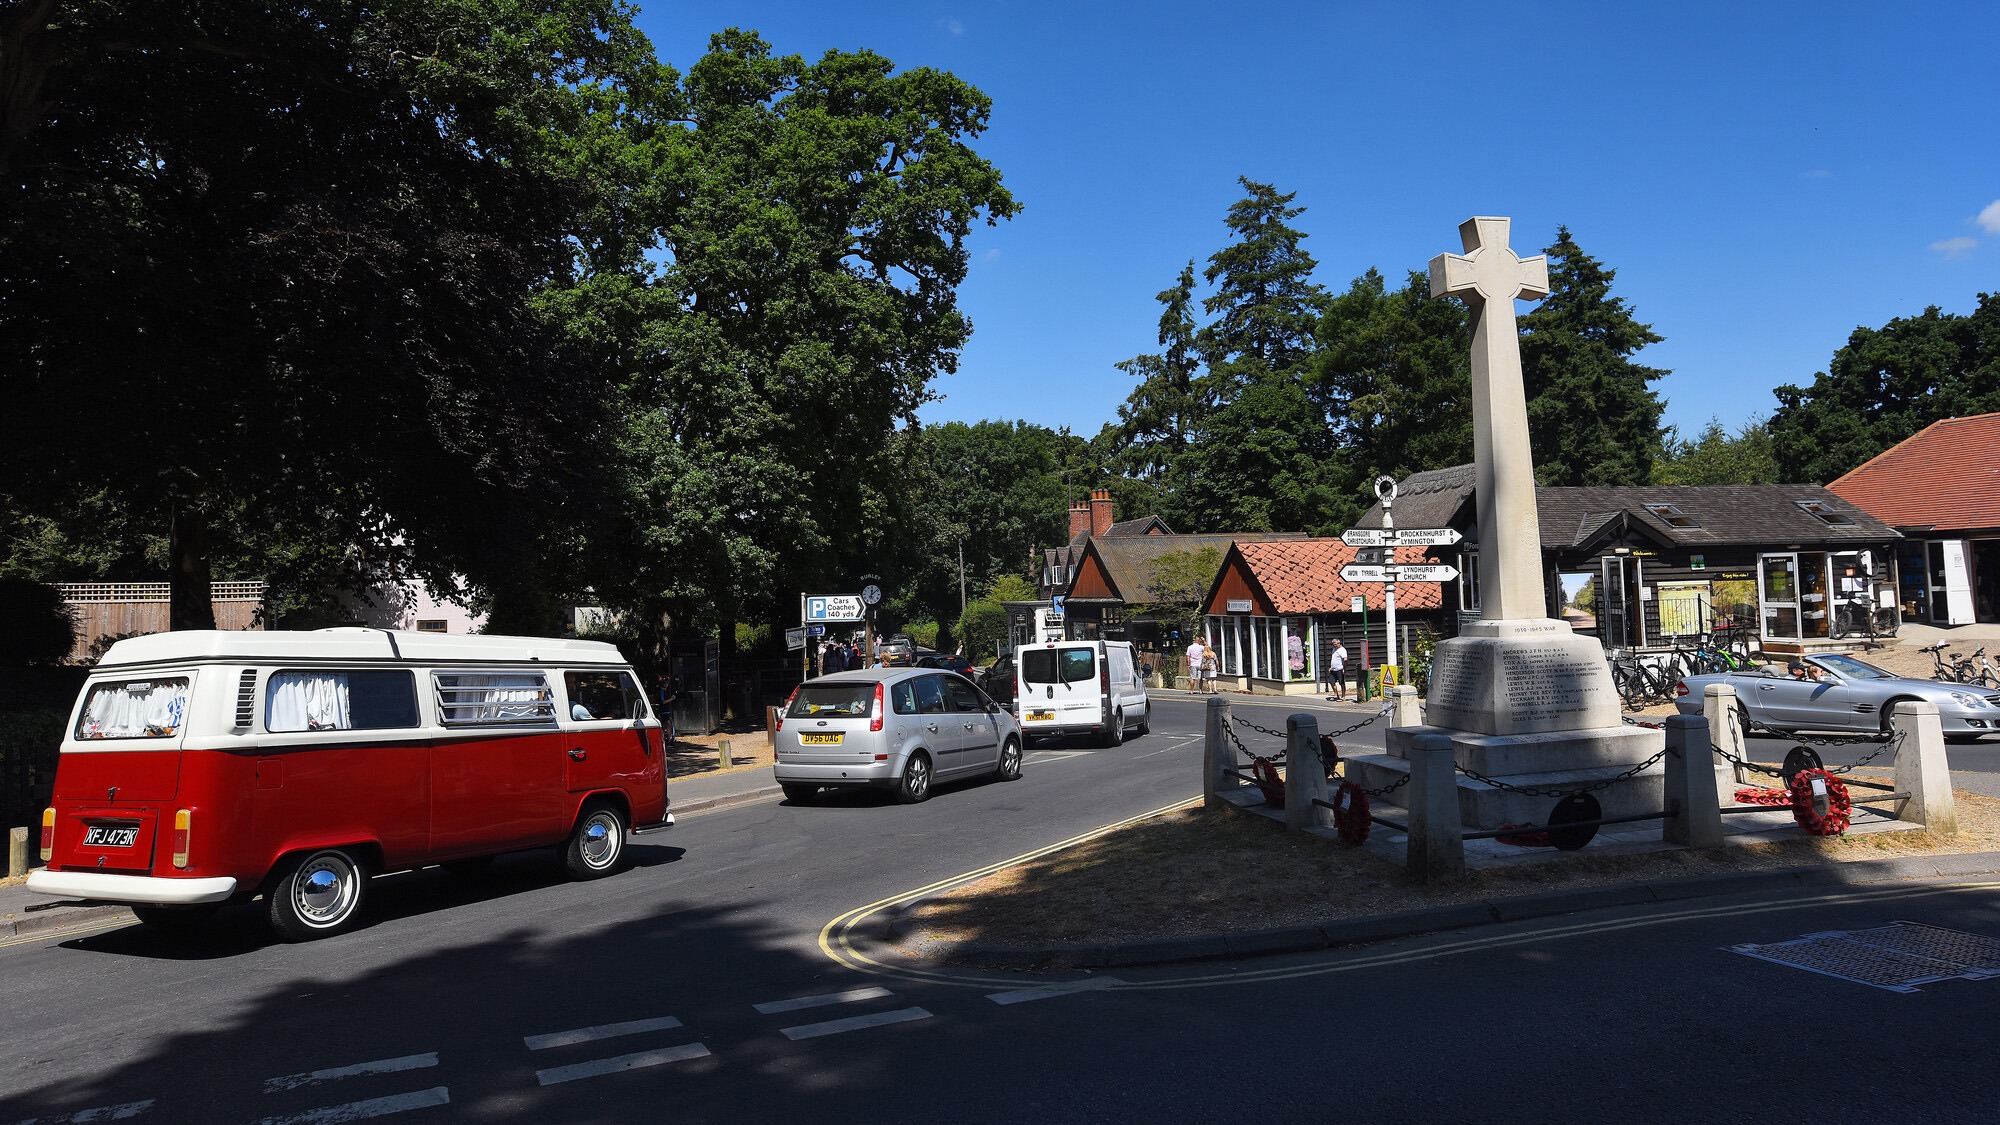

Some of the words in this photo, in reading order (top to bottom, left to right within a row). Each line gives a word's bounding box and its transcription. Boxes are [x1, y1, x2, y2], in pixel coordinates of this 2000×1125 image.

[805, 734, 822, 742] DV56
[824, 734, 838, 742] UAG
[85, 828, 108, 844] XFJ
[107, 829, 136, 845] 473K
